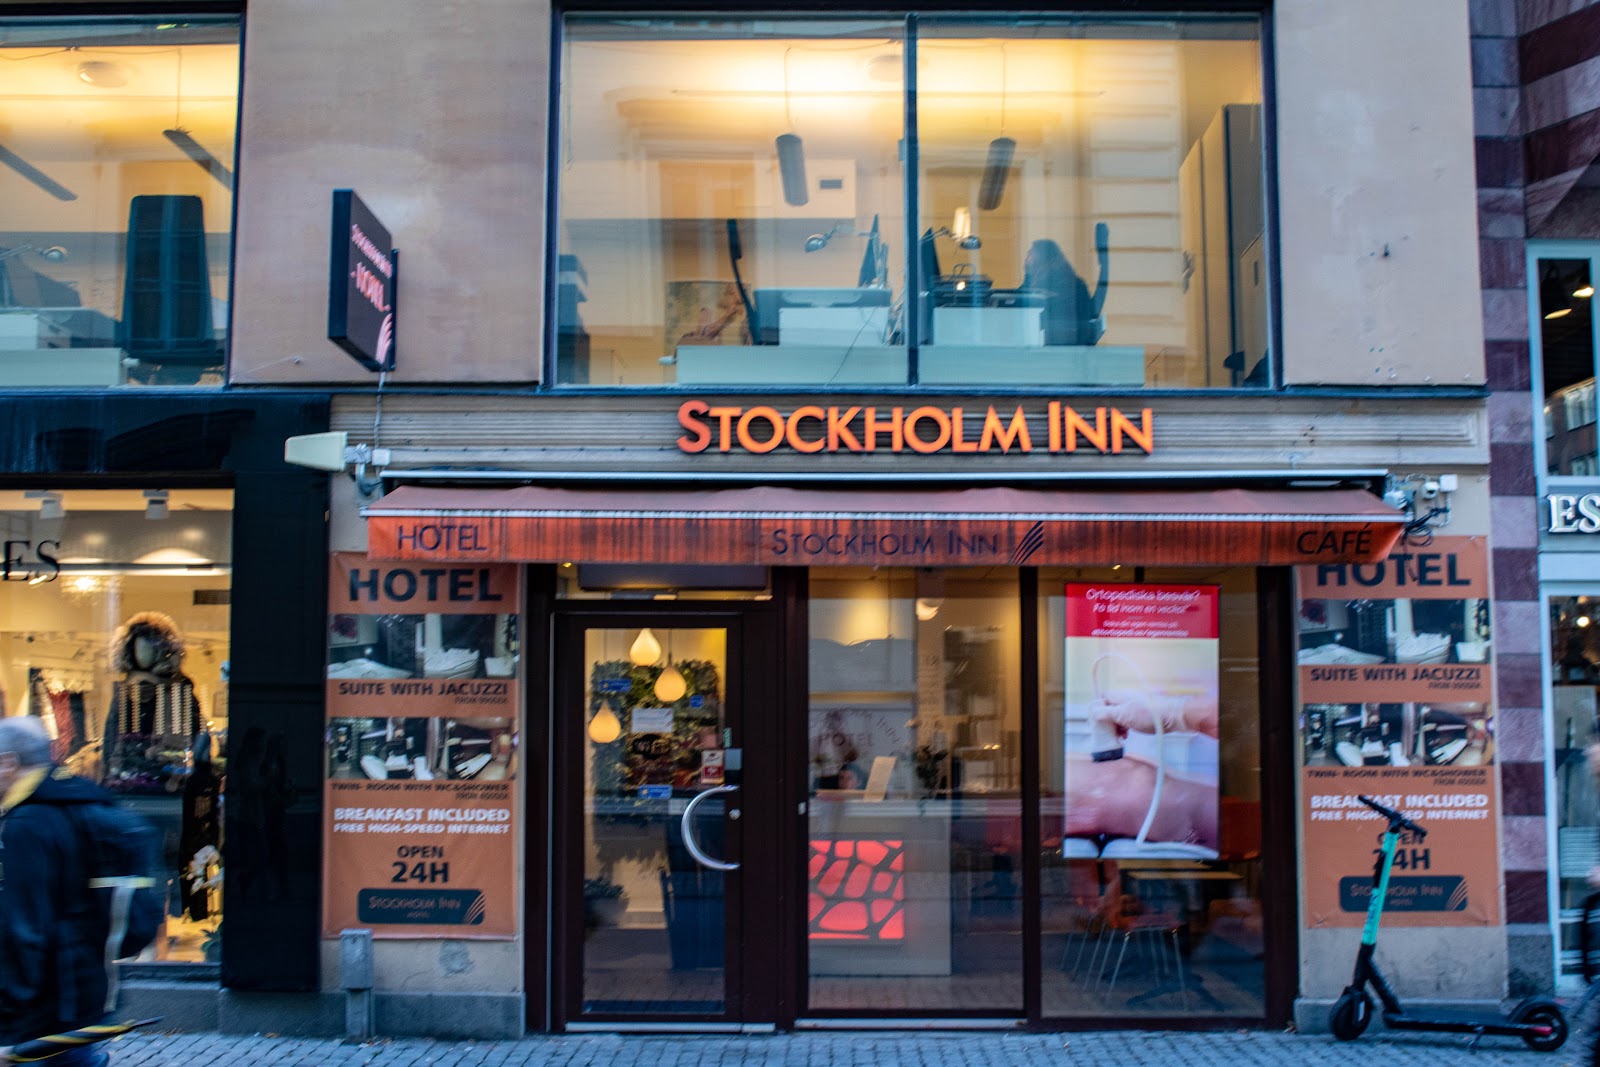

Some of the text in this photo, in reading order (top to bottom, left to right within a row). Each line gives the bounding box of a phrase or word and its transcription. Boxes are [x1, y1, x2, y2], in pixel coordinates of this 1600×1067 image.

[676, 400, 1153, 454] STOCKHOLM INN
[397, 525, 487, 551] HOTEL
[772, 529, 998, 555] STOCKHOLM INN
[1297, 522, 1372, 555] CAFÉ
[349, 568, 502, 602] HOTEL
[1311, 667, 1481, 681] SUITE WITH JACUZZI
[338, 682, 508, 695] SUITE WITH JACUZZI
[1405, 794, 1488, 808] INCLUDED
[333, 808, 511, 821] BREAKFAST INCLUDED
[1311, 810, 1344, 820] FREE
[1426, 810, 1488, 820] INTERNET
[333, 823, 366, 833] FREE
[447, 824, 511, 834] INTERNET
[397, 846, 443, 859] OPEN
[391, 862, 449, 883] 24H
